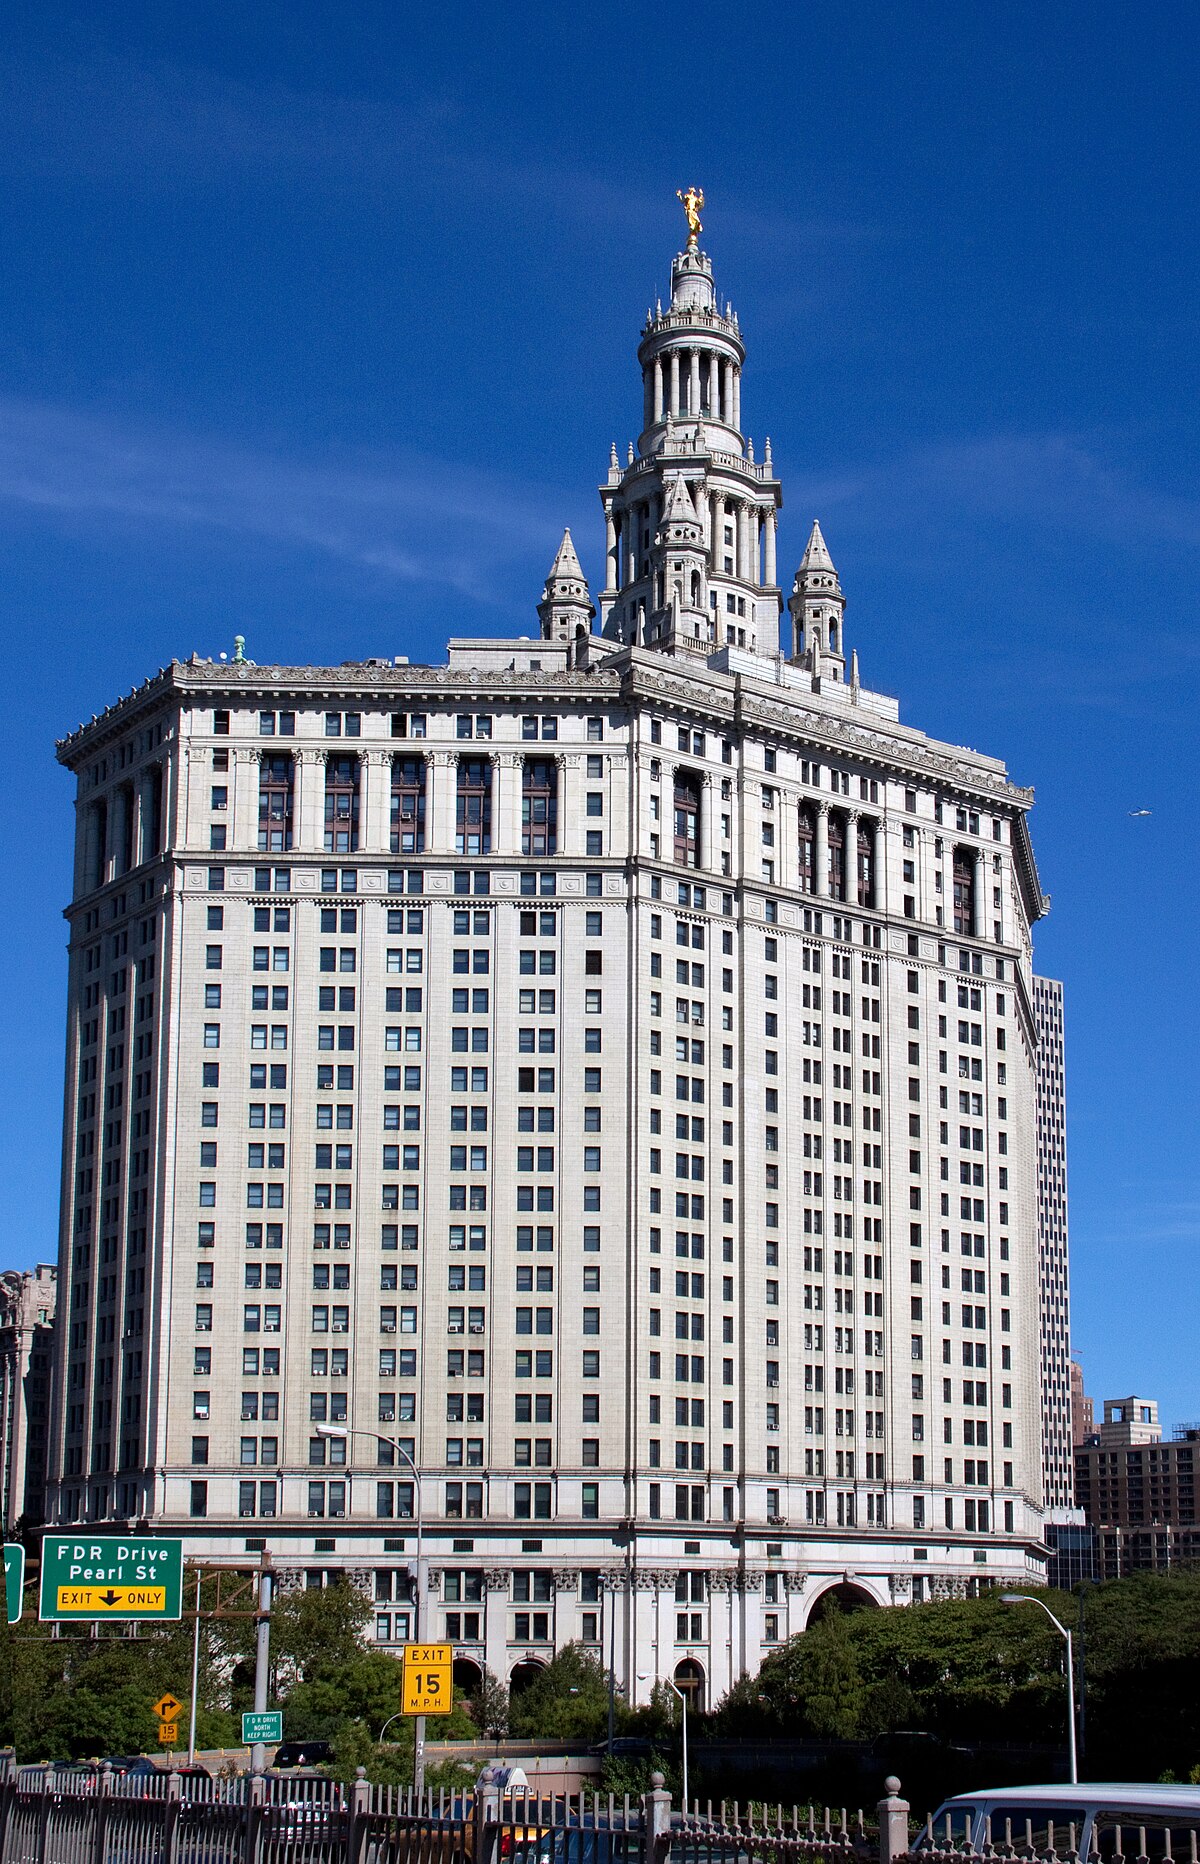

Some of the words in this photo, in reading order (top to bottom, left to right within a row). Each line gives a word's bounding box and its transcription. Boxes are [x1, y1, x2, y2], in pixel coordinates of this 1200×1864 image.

[57, 1546, 102, 1560] FDR
[117, 1546, 168, 1560] Drive
[70, 1565, 122, 1580] Pearl
[136, 1566, 156, 1580] St
[61, 1592, 92, 1604] EXIT
[128, 1592, 162, 1604] ONLY
[412, 1650, 444, 1660] EXIT
[416, 1674, 440, 1694] 15
[164, 1726, 174, 1734] 15
